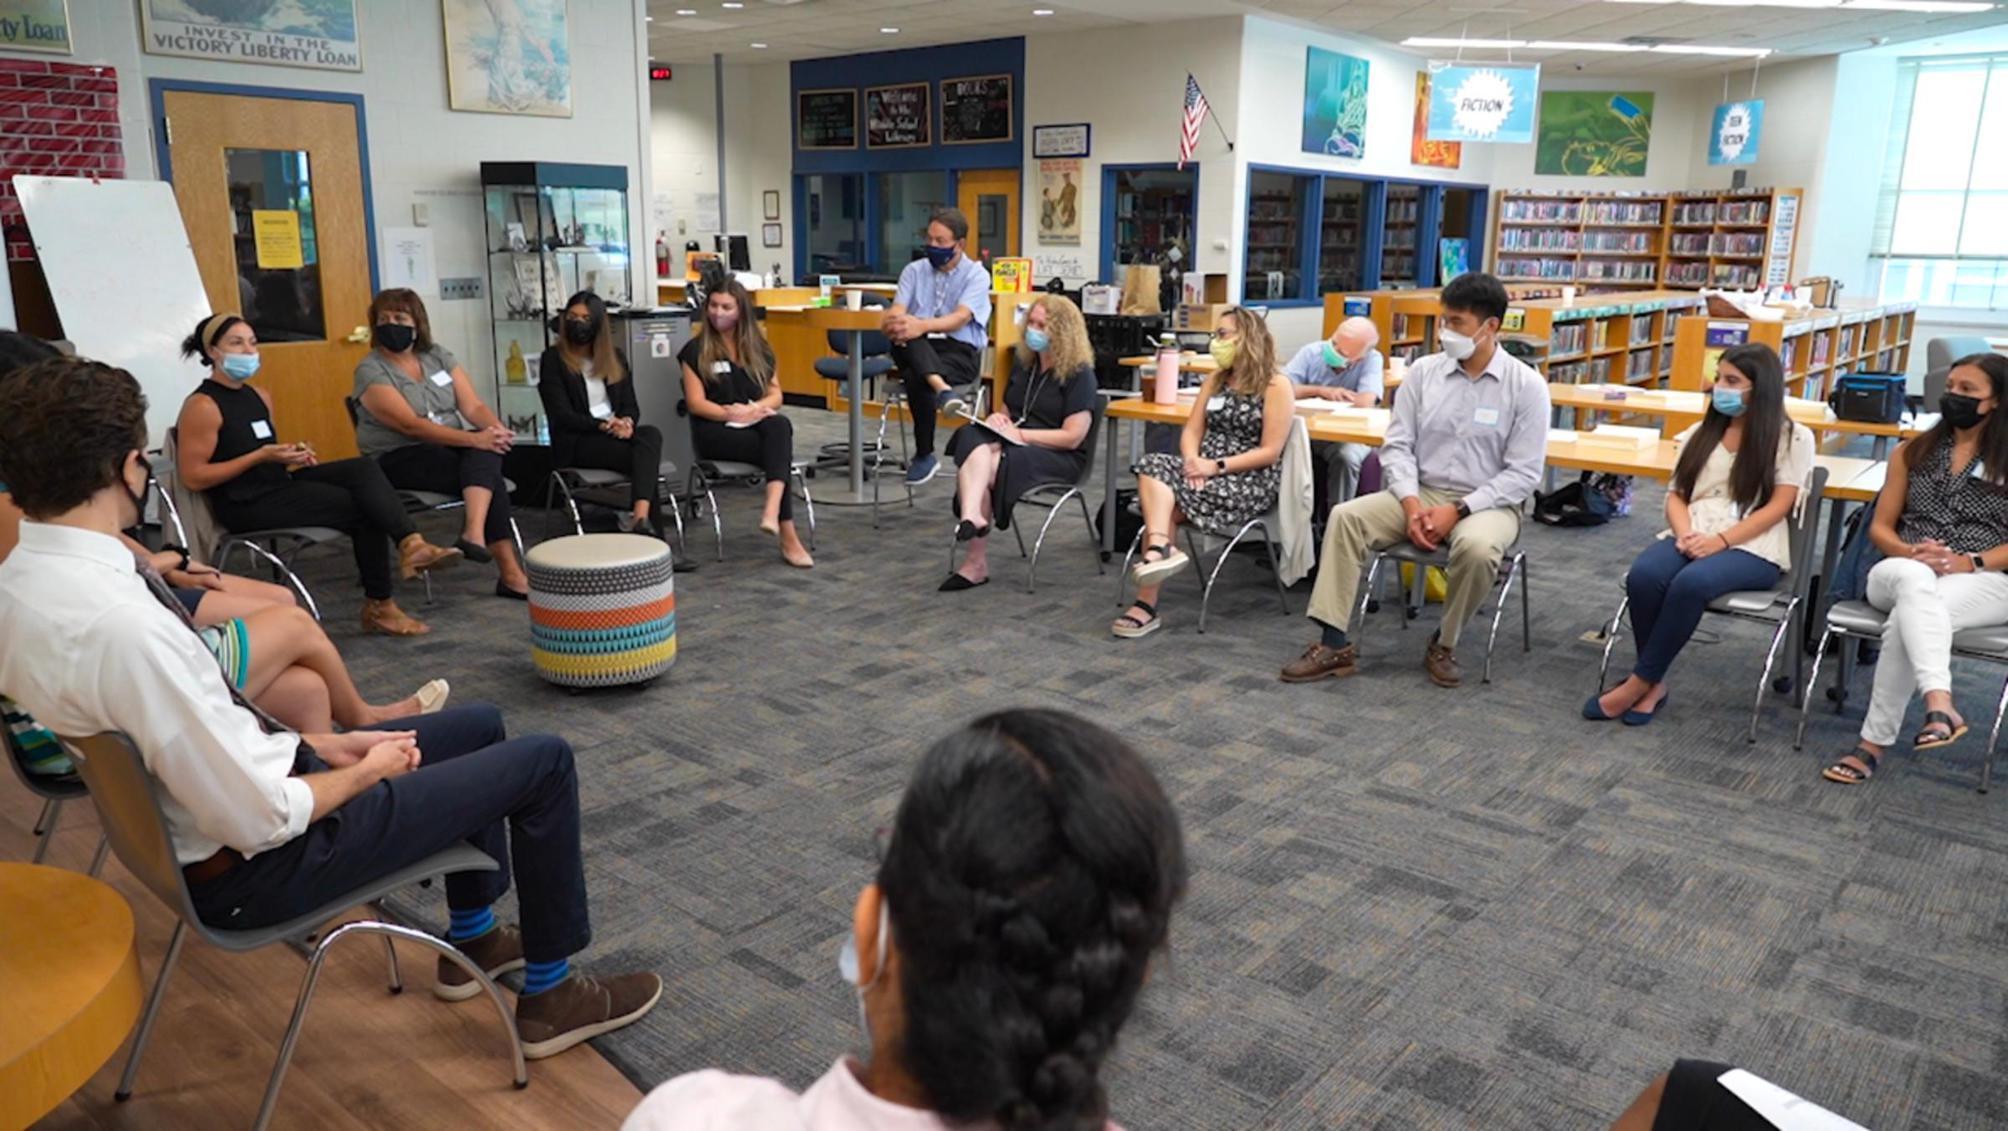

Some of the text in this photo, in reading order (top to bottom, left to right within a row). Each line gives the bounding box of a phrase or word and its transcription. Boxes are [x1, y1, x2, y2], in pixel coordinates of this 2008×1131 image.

[22, 15, 66, 40] Loan
[184, 25, 332, 50] INVEST IN THE
[153, 33, 357, 66] VICTORY LIBERTY LOAN
[1460, 97, 1504, 112] FICTION
[1723, 134, 1744, 145] FICTION
